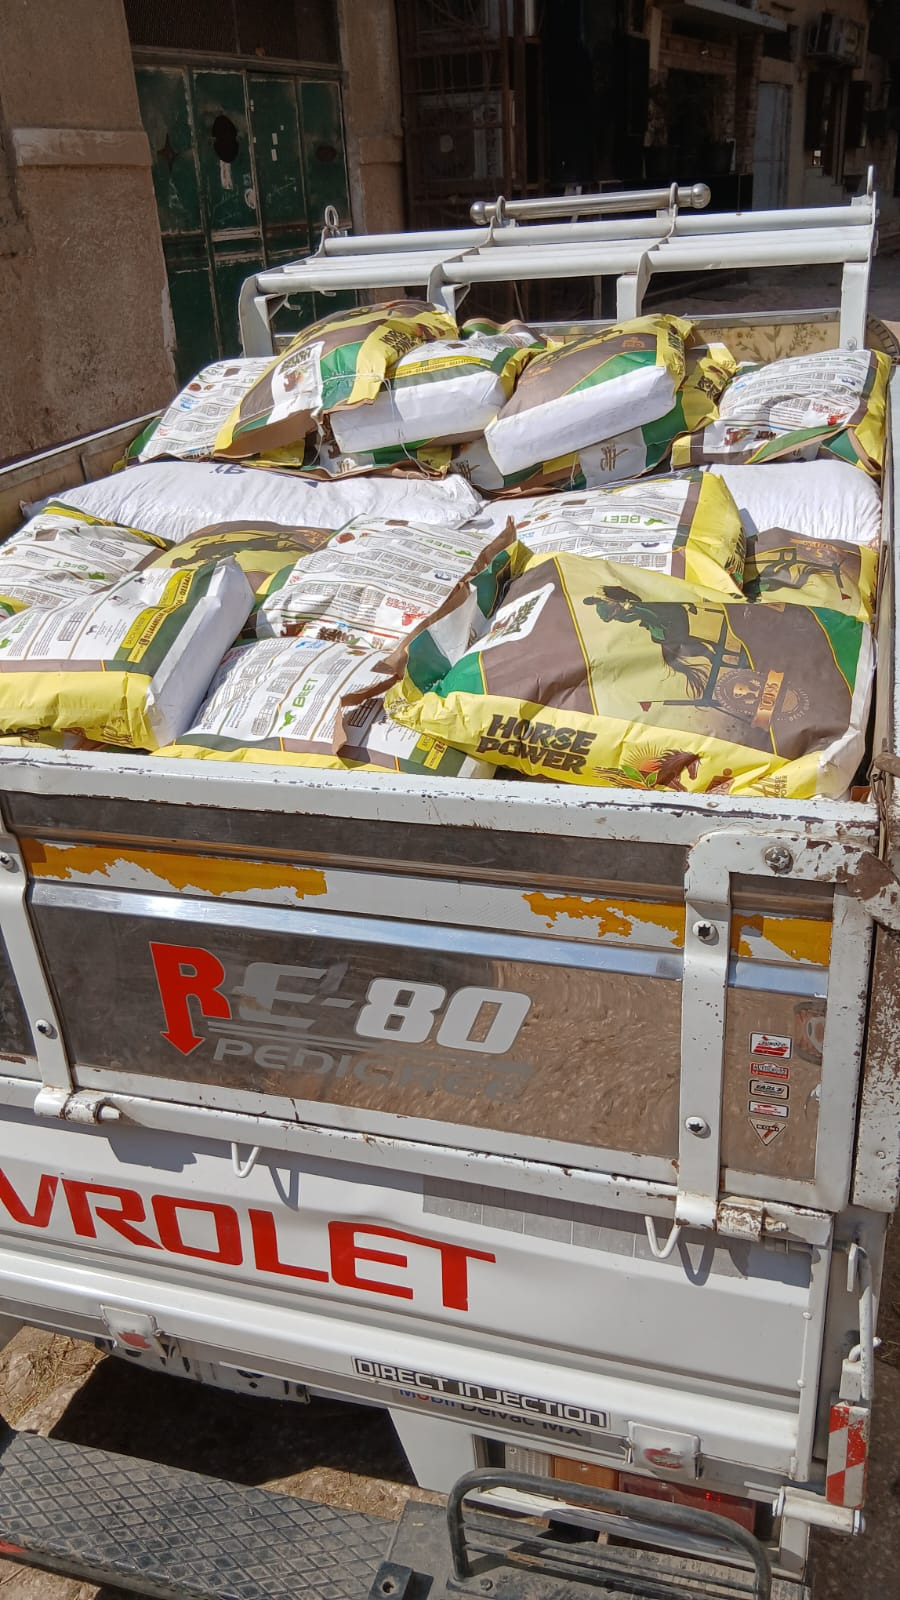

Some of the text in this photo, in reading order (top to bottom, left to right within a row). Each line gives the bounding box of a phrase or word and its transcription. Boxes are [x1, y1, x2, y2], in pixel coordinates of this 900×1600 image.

[603, 514, 641, 524] BEET
[292, 678, 318, 708] BEET
[486, 713, 598, 756] HORSE
[476, 735, 588, 775] POWER
[356, 1359, 607, 1427] DIRECT INJECTION
